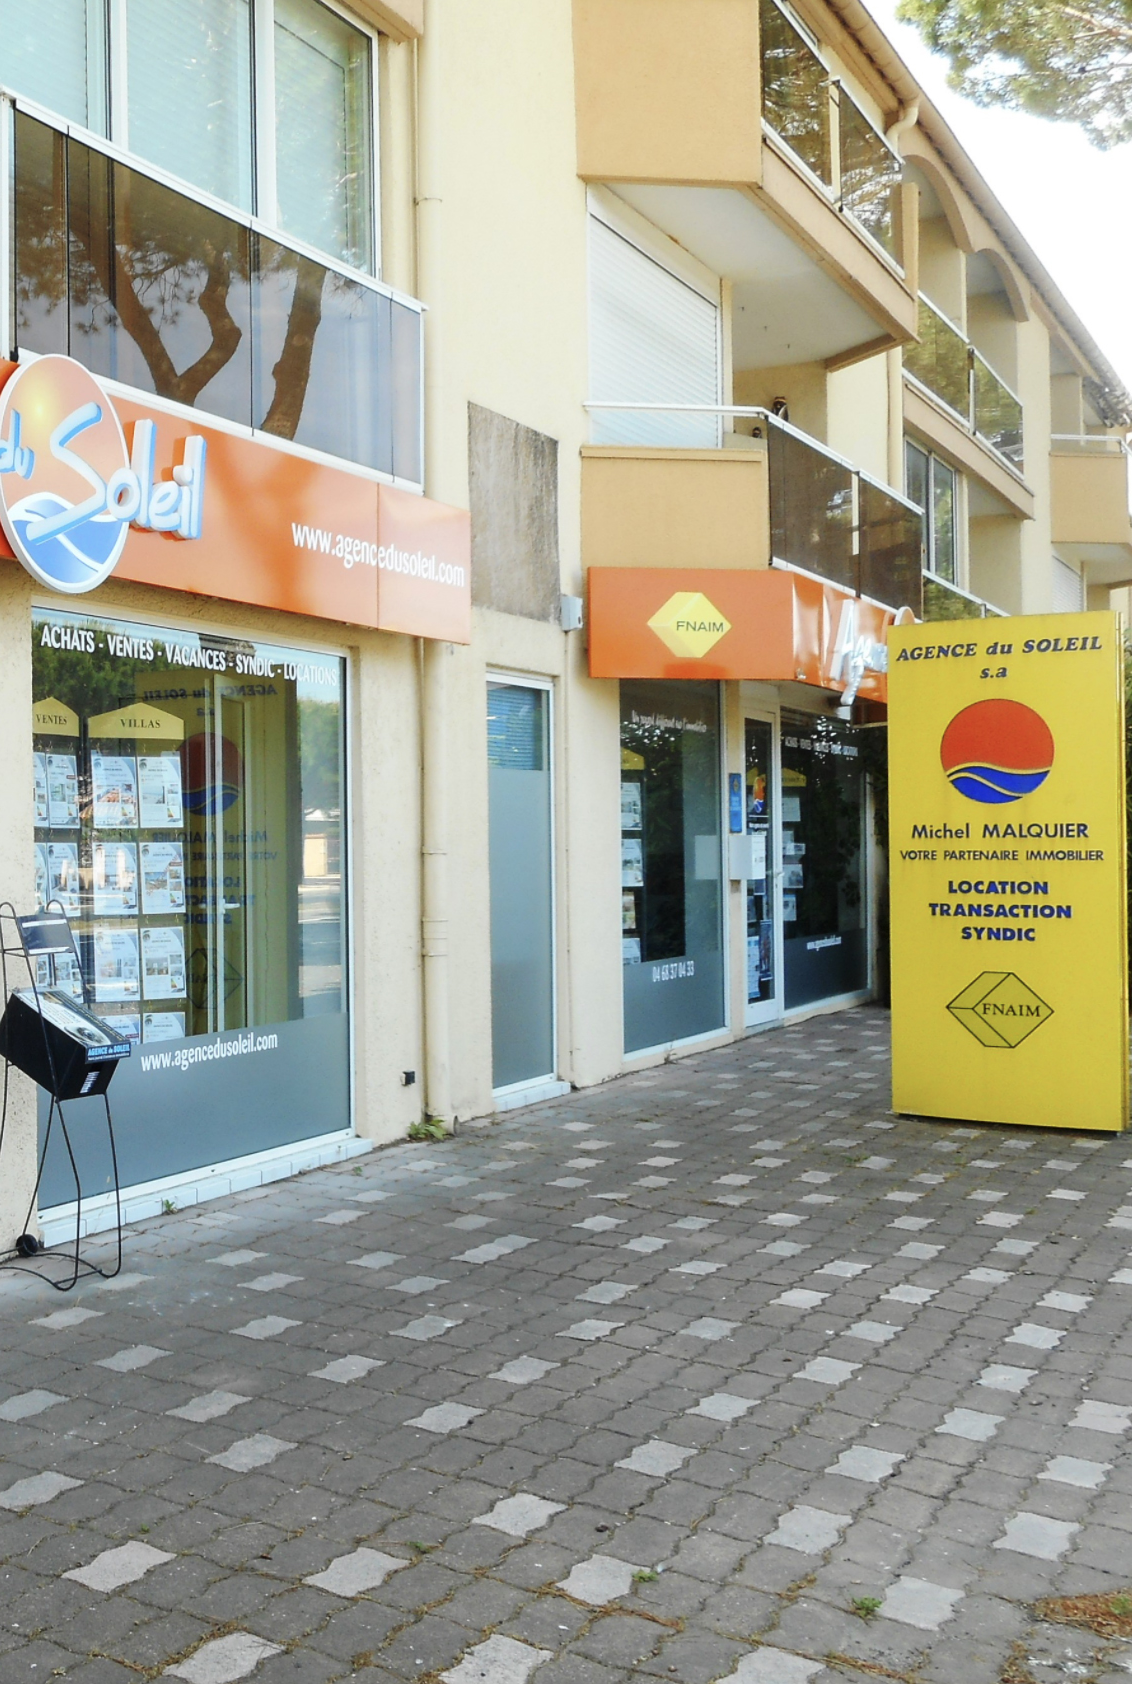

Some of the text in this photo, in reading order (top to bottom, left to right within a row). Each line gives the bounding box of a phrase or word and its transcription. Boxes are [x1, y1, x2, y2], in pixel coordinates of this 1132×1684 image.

[25, 402, 207, 546] Soleil
[291, 522, 465, 588] www.agencedusoleil.com
[676, 620, 725, 634] FNAIM
[40, 624, 95, 653] ACHATS
[107, 635, 155, 662] VENTES
[165, 644, 226, 672] VACANCES
[235, 657, 275, 679] SYNDIC
[283, 663, 338, 687] LOCATIONS
[896, 636, 1102, 661] AGENCE du SOLEIL
[980, 666, 1008, 679] s.a
[36, 713, 68, 727] VENTES
[120, 718, 161, 729] VILLAS
[912, 823, 1089, 839] Michel MALQUIER
[900, 850, 1104, 861] VOTRE PARTENAIRE IMMOBILIER
[948, 881, 1049, 895] LOCATION
[929, 903, 1072, 918] TRANSACTION
[962, 927, 1035, 941] SYNDIC
[982, 1003, 1041, 1018] FNAIM
[141, 1030, 278, 1071] www.agencedusoleil.com
